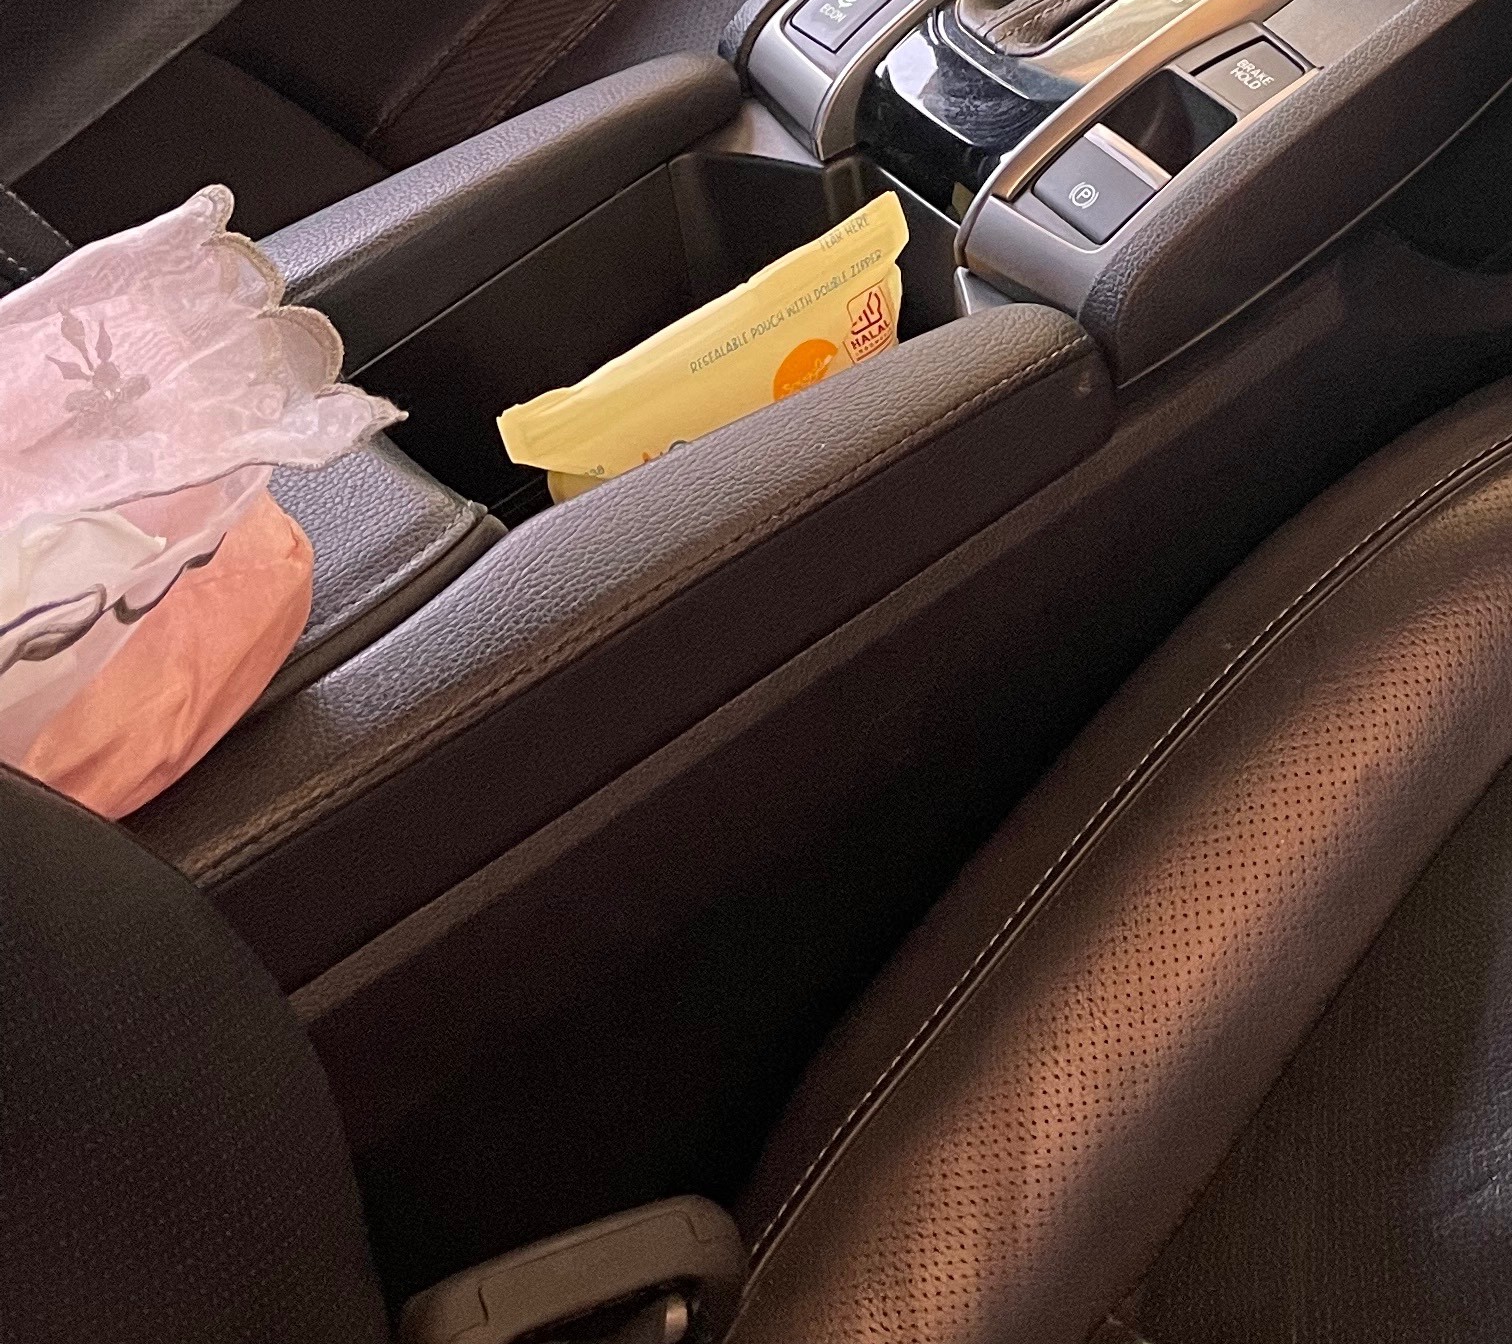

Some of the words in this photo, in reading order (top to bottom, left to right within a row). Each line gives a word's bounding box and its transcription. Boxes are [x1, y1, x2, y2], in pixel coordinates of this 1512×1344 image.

[820, 3, 847, 22] ECON
[1230, 66, 1262, 90] HOLD
[1236, 58, 1275, 87] BRAKE
[844, 213, 870, 235] HERE
[690, 333, 750, 374] RESEALABLE
[750, 310, 785, 339] POUCH
[786, 294, 814, 318] WITH
[813, 270, 848, 301] DOUBLE
[850, 249, 882, 278] ZIPPER
[850, 319, 891, 350] HALAL
